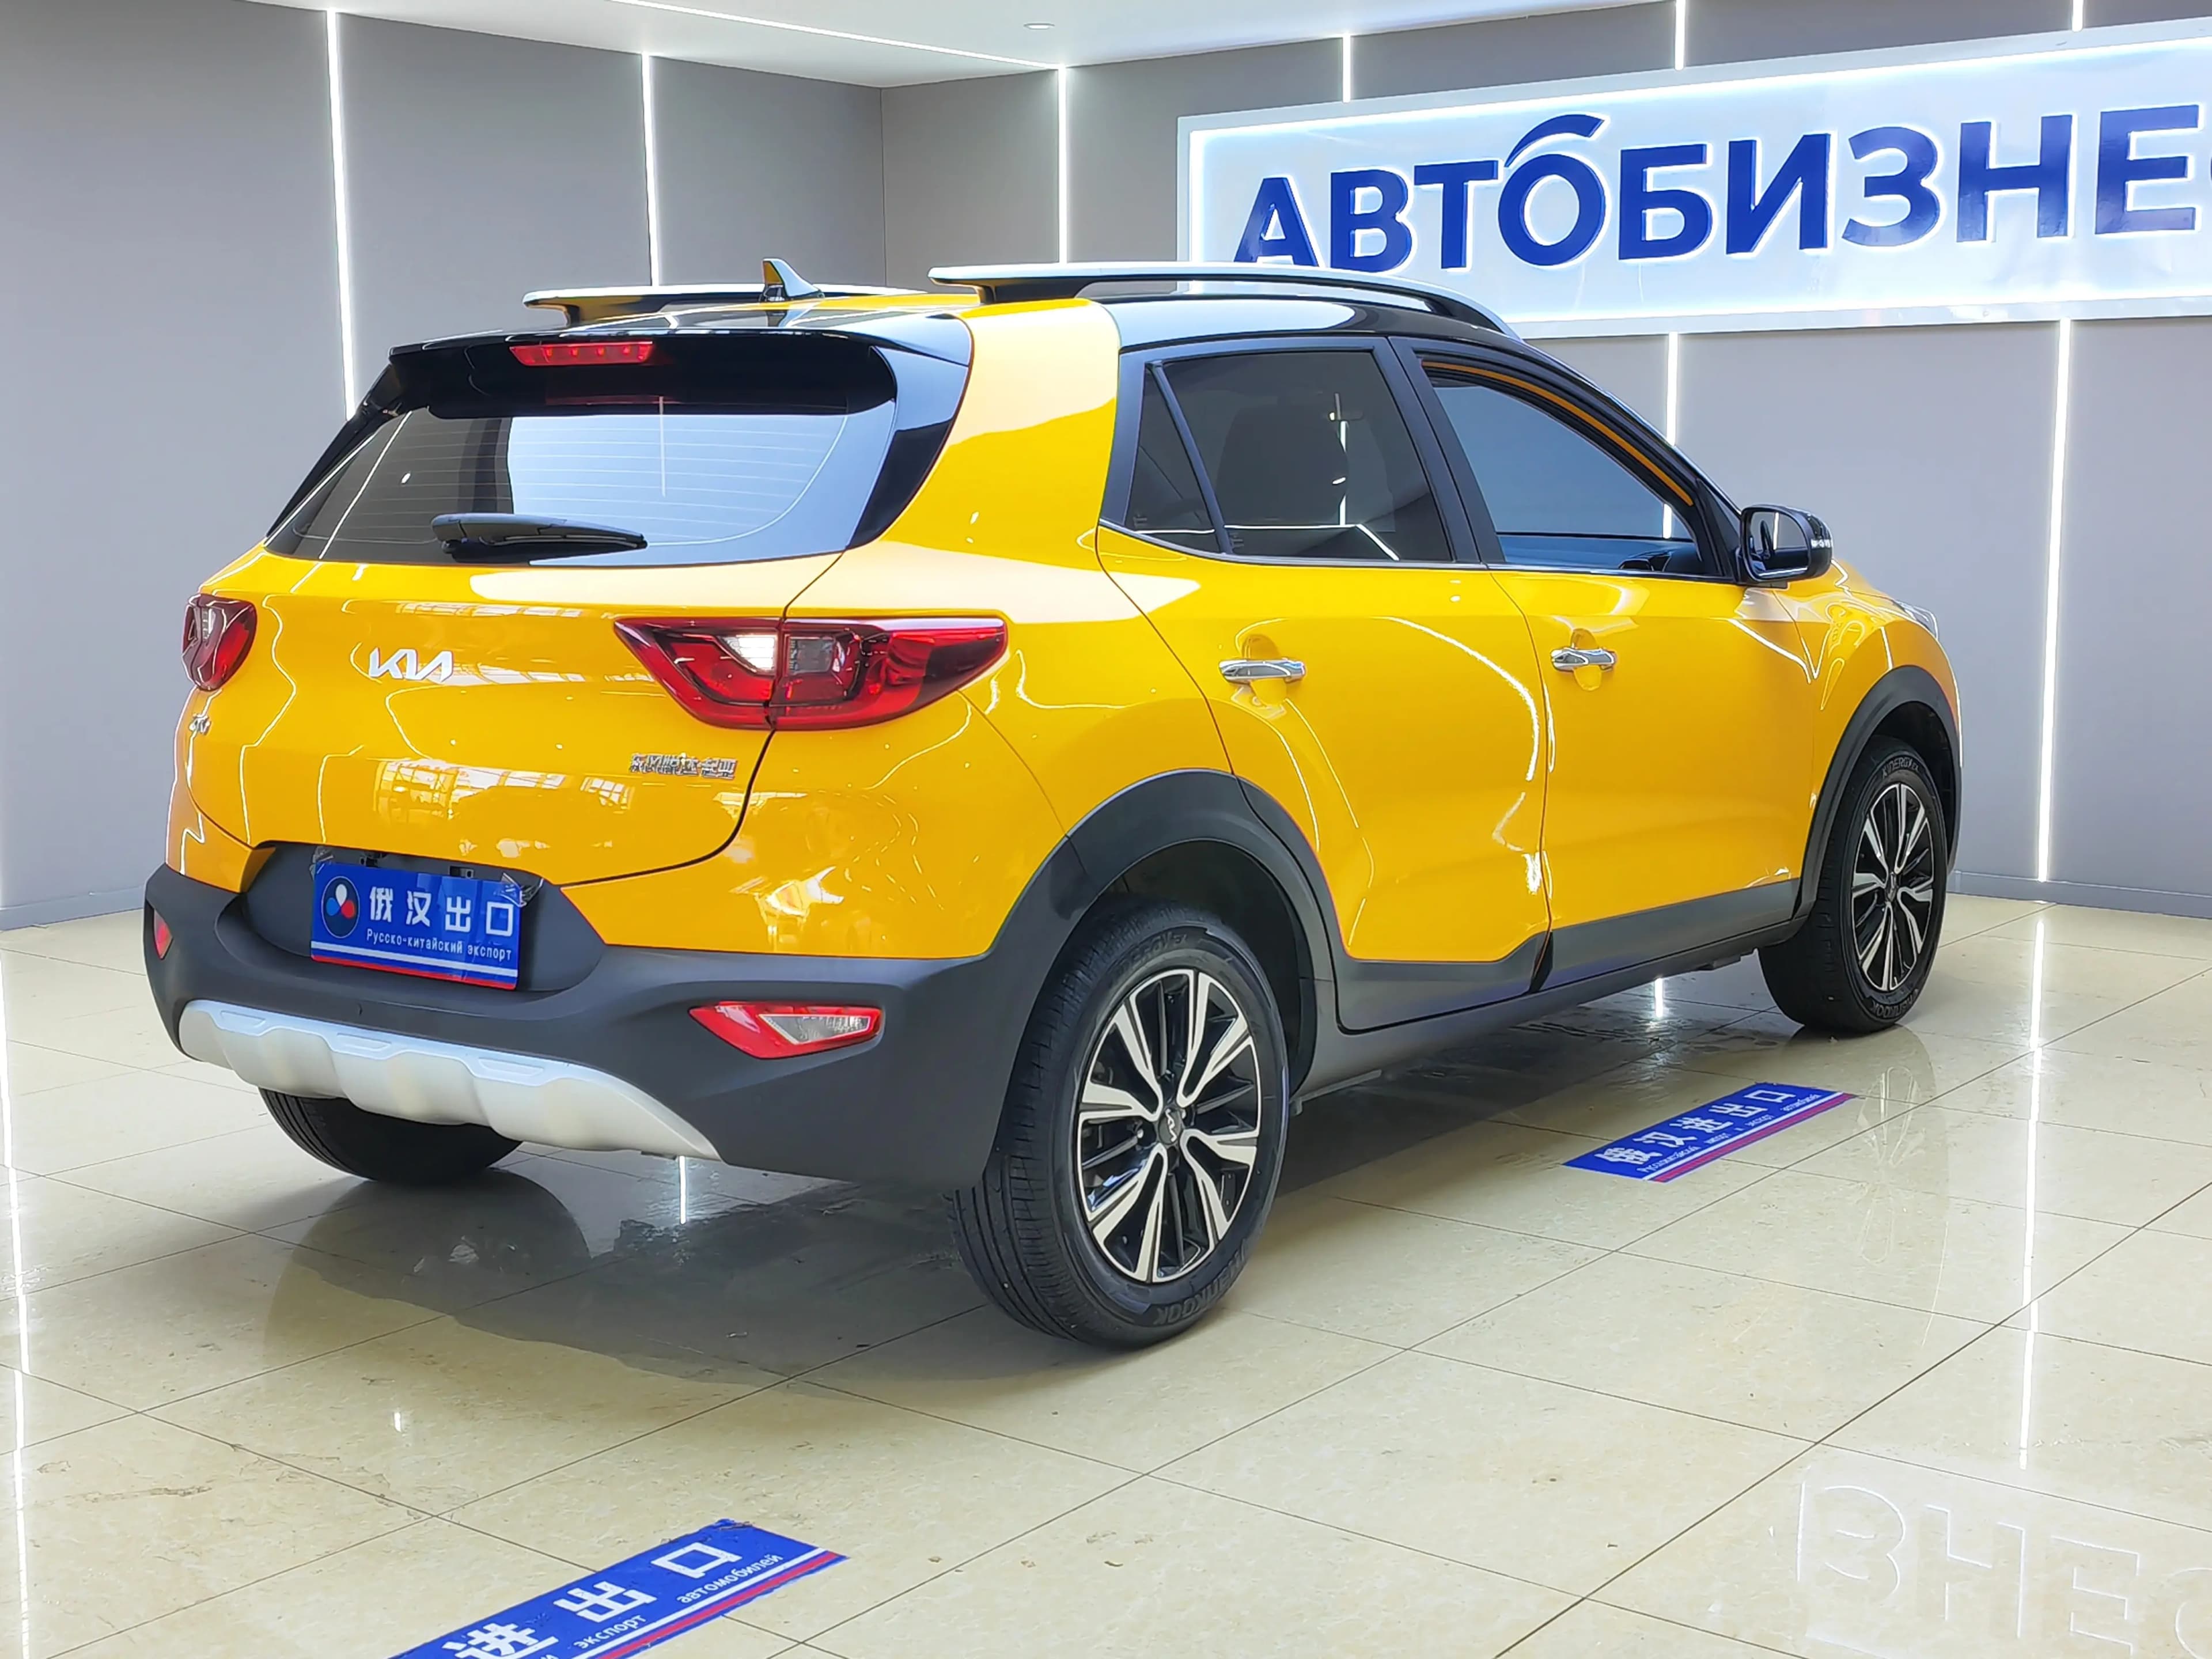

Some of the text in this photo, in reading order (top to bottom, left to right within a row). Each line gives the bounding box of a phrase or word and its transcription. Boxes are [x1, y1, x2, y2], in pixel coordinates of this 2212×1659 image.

[1234, 104, 2212, 272] АВТОБИЗНЕ
[369, 647, 454, 682] KIA
[366, 928, 512, 963] Русско-китайский экспорт
[1594, 1089, 1796, 1165] 俄汉进出口
[574, 1553, 784, 1649] экспорт автомобилей
